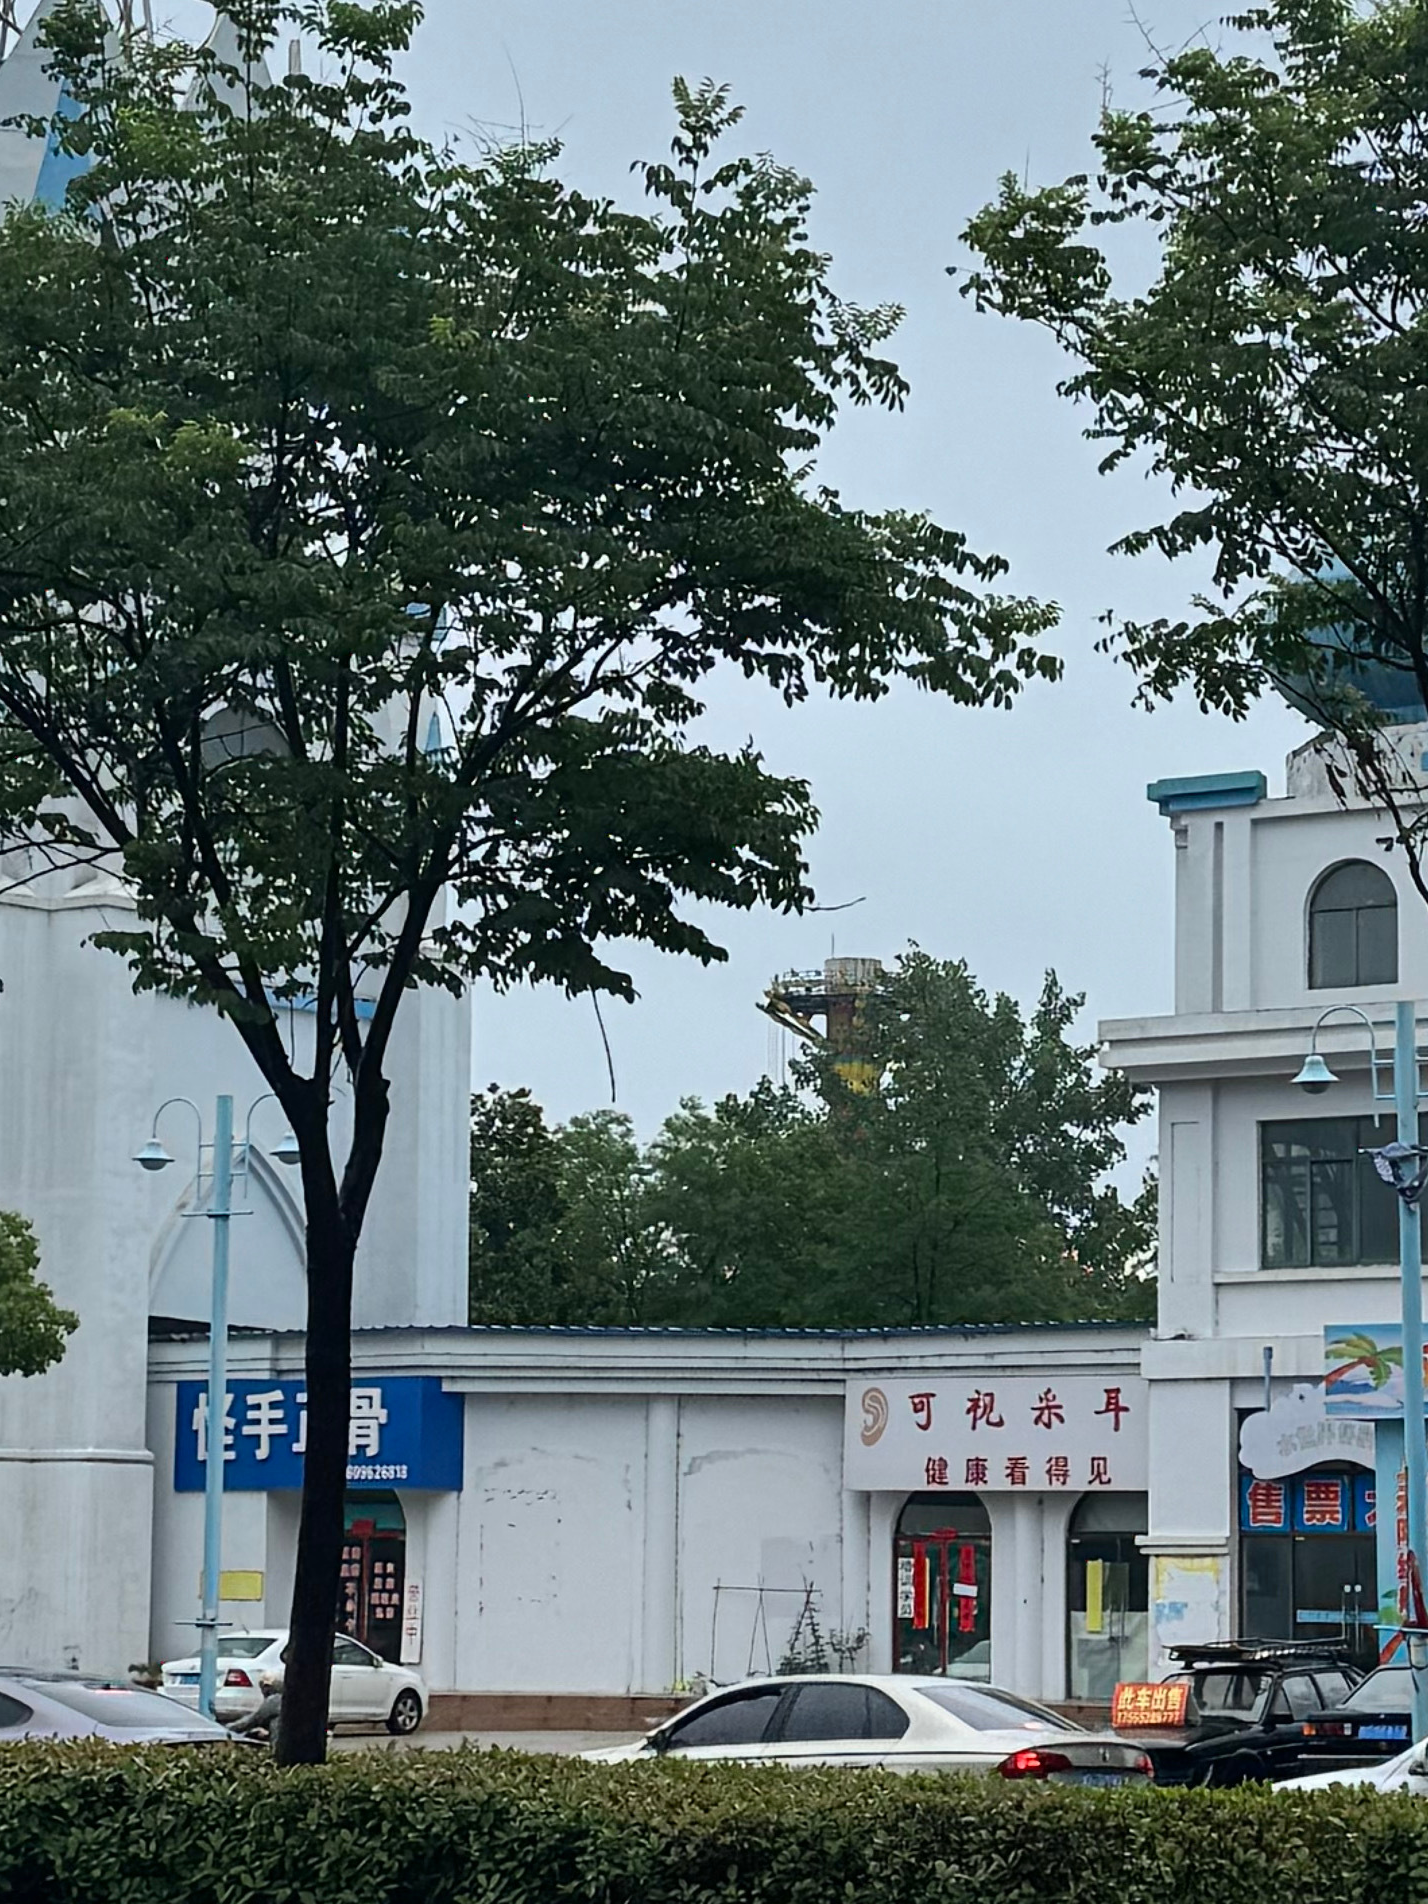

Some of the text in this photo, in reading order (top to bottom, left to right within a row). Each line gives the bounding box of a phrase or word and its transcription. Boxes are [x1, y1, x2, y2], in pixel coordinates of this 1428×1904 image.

[908, 1387, 1131, 1433] 可视采耳
[924, 1456, 1112, 1486] 健康看得见
[1246, 1479, 1376, 1527] 售票
[1117, 1686, 1184, 1711] 此车出售
